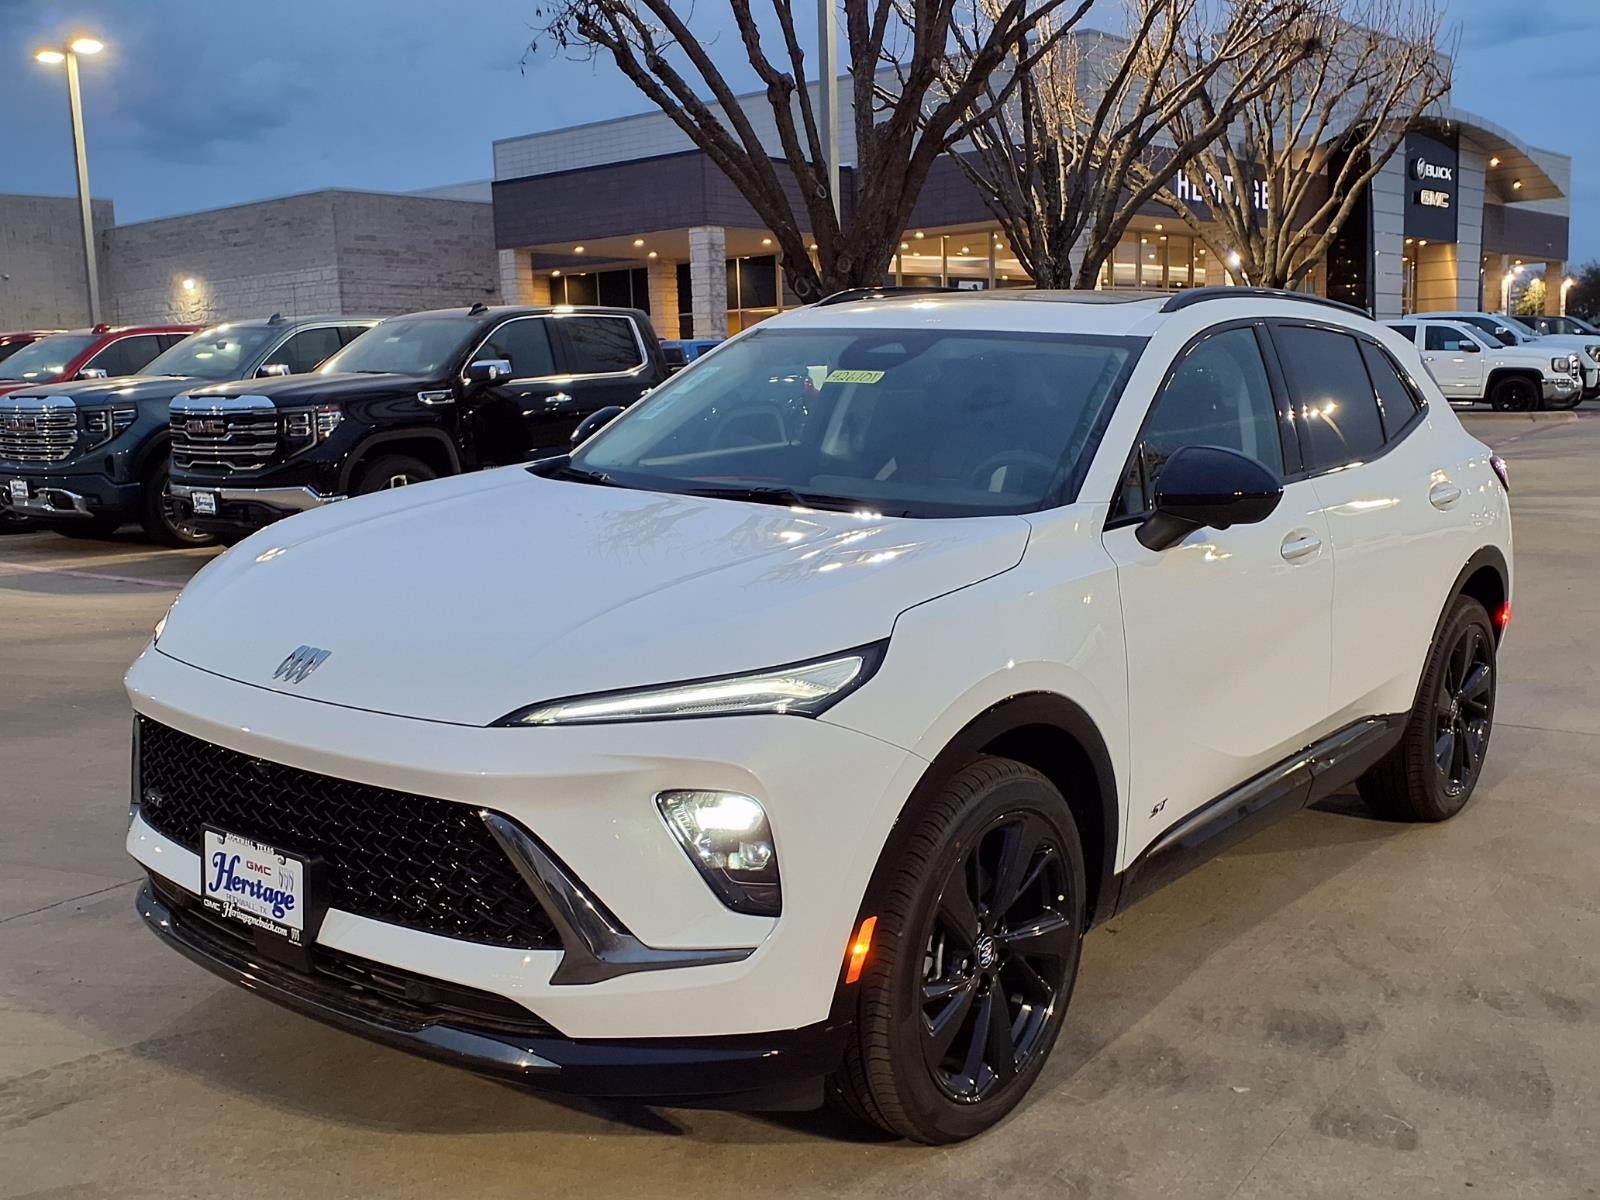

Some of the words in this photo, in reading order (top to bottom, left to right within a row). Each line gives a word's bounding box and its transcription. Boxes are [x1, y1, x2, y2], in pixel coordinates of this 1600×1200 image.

[1425, 163, 1452, 181] BUICK
[1421, 189, 1450, 208] GMC
[185, 419, 225, 433] GMC
[246, 860, 272, 876] GMC
[209, 852, 294, 918] Heritage
[203, 898, 221, 912] GMC
